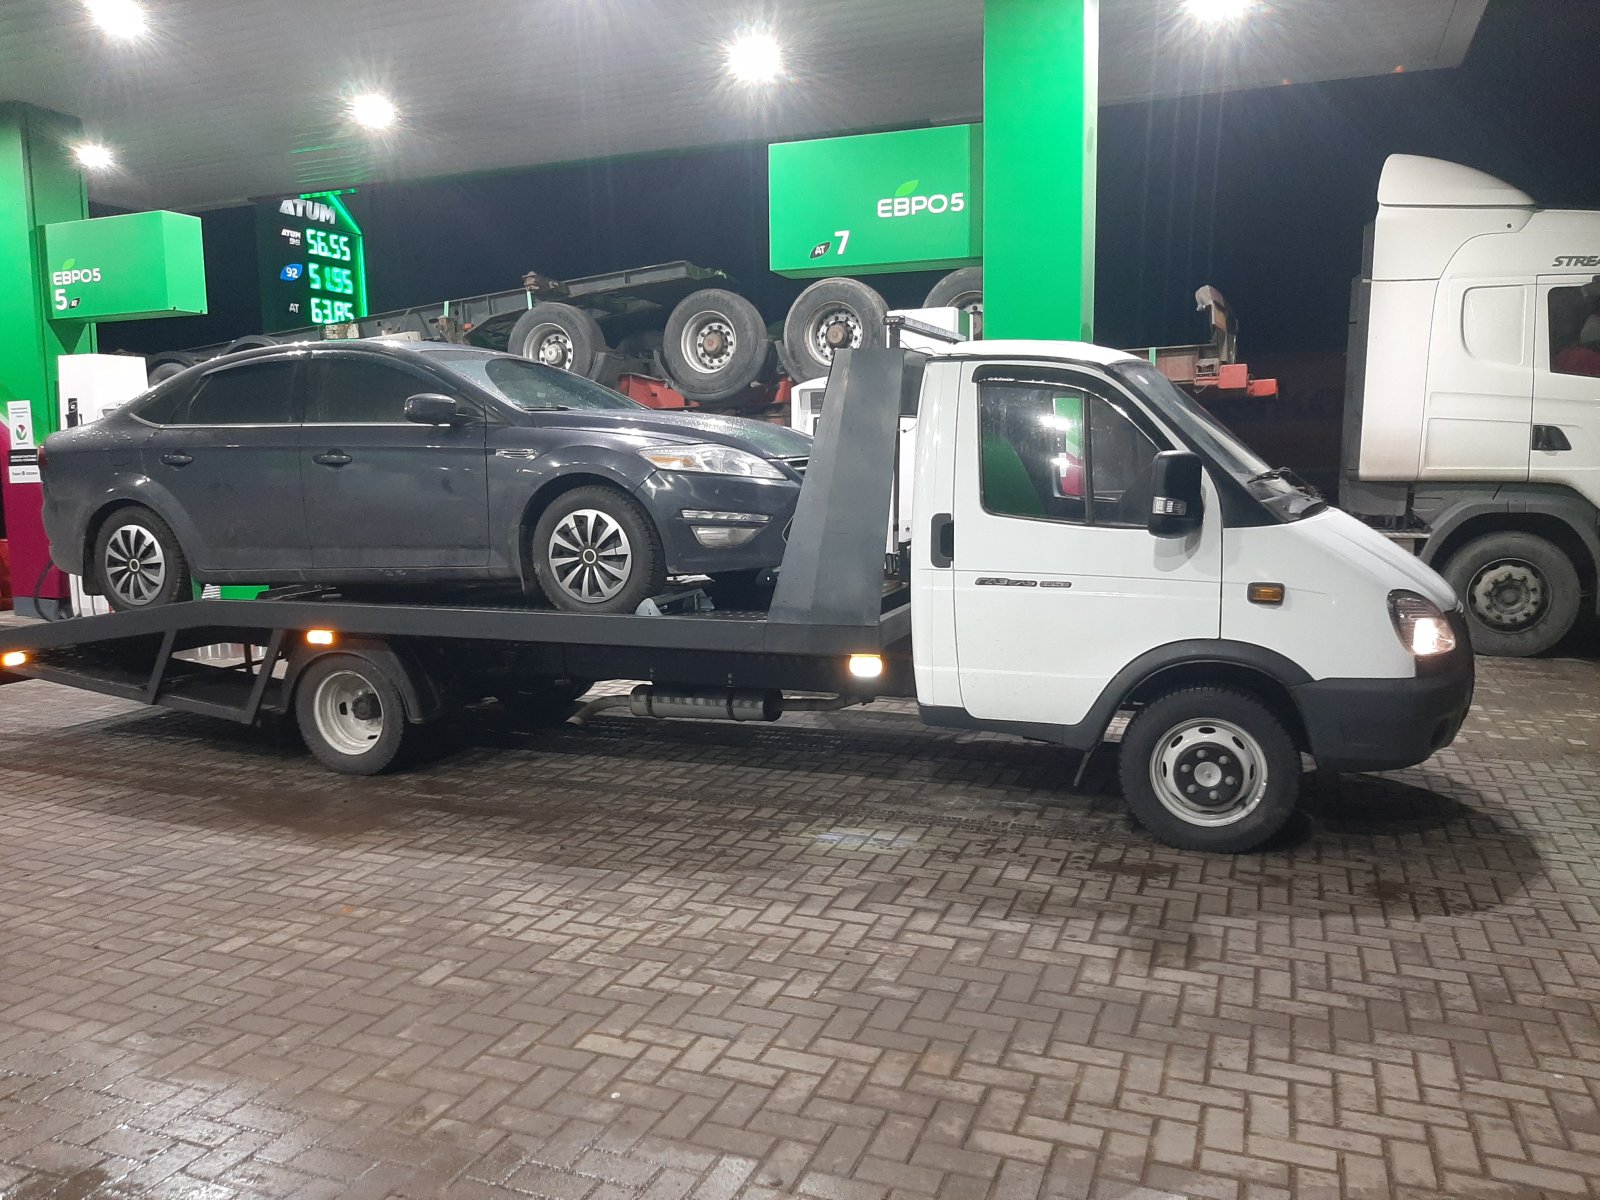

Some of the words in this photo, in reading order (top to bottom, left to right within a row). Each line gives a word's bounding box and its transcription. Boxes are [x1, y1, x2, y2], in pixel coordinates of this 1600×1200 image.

[834, 230, 850, 255] 7
[285, 267, 299, 279] 92
[55, 288, 68, 310] 5
